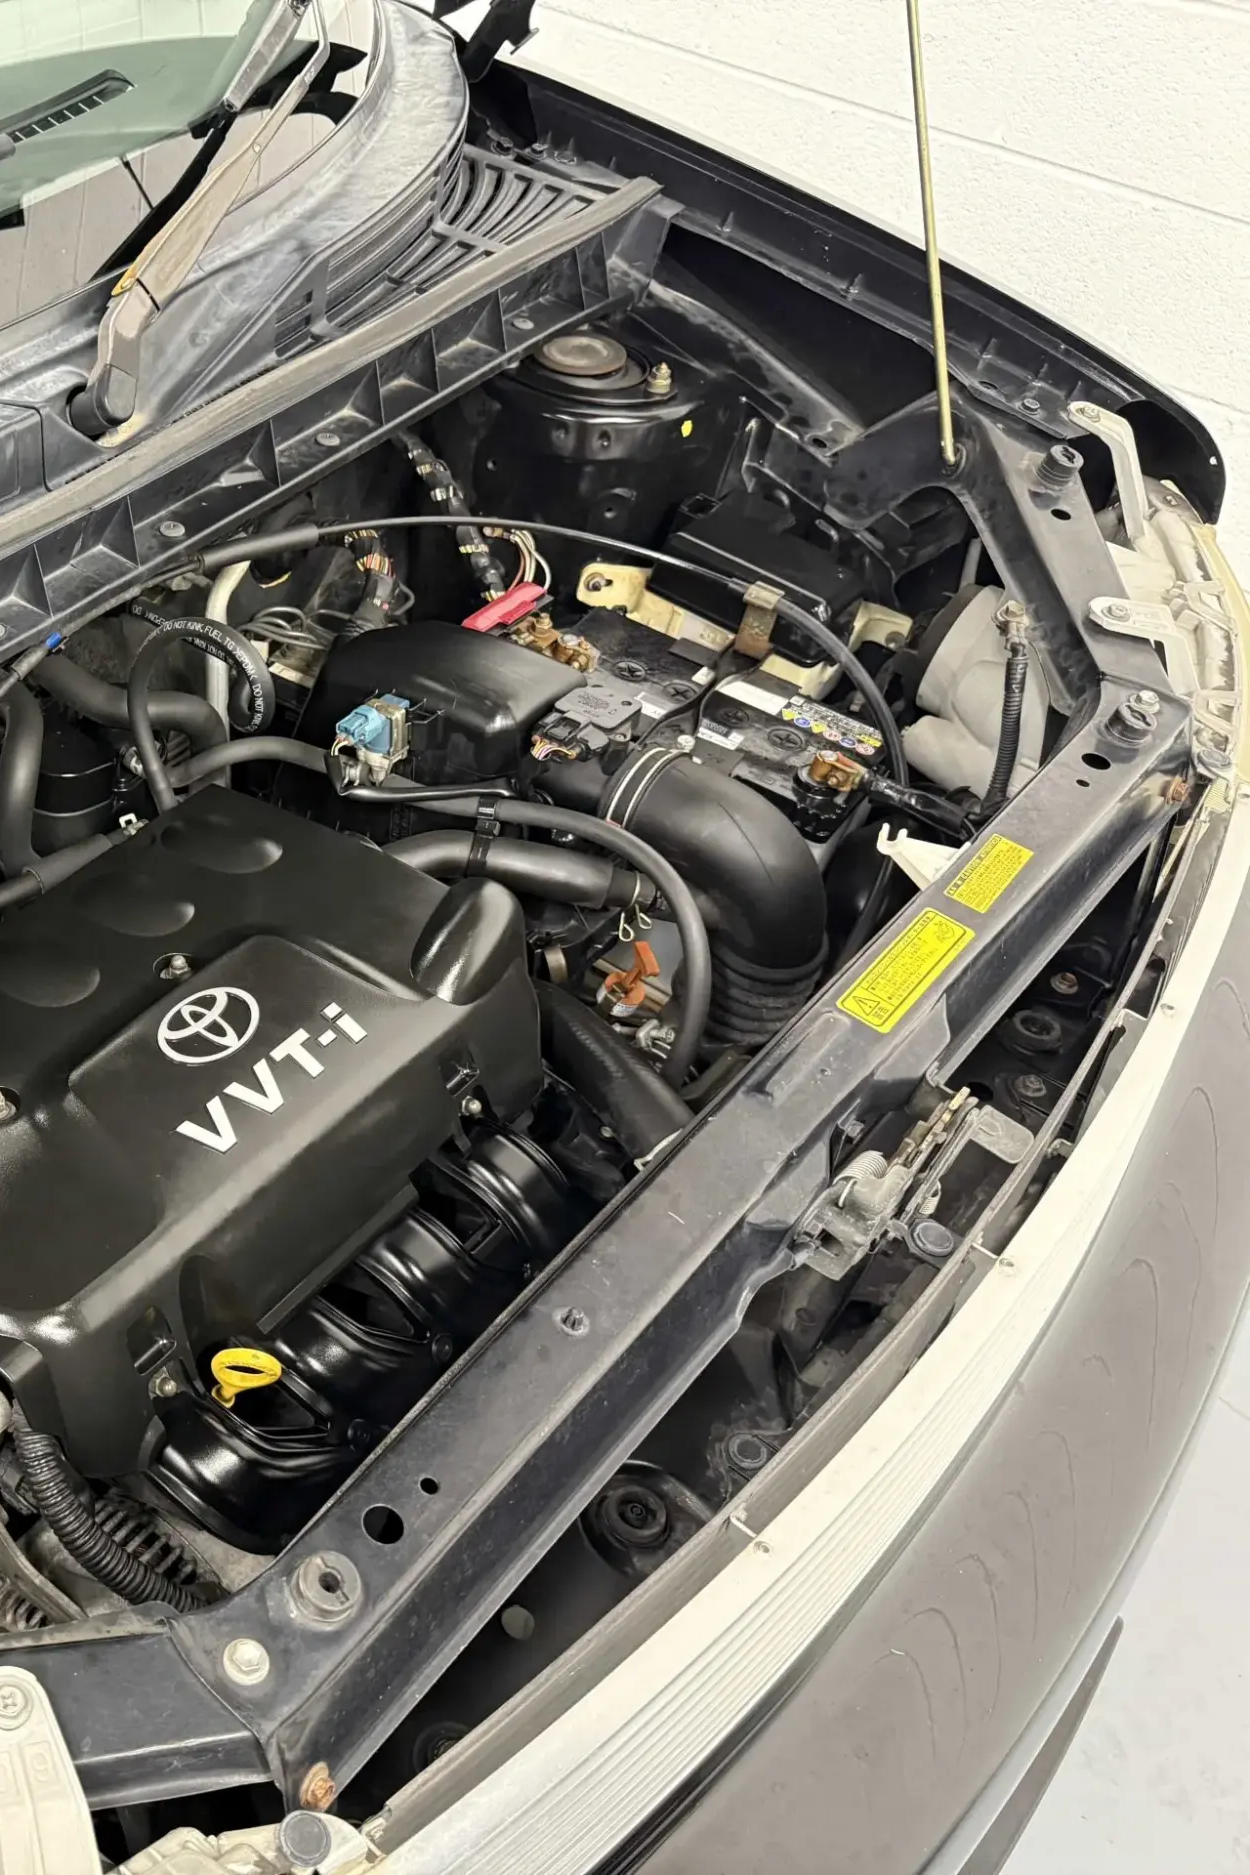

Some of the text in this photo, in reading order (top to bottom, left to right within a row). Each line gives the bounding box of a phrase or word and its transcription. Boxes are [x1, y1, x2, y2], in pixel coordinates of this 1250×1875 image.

[173, 620, 187, 629] NOT
[204, 626, 223, 643] FUEL
[223, 636, 236, 651] TG
[252, 683, 264, 697] DO
[254, 696, 265, 713] NOT
[175, 1001, 368, 1154] VVT-i
